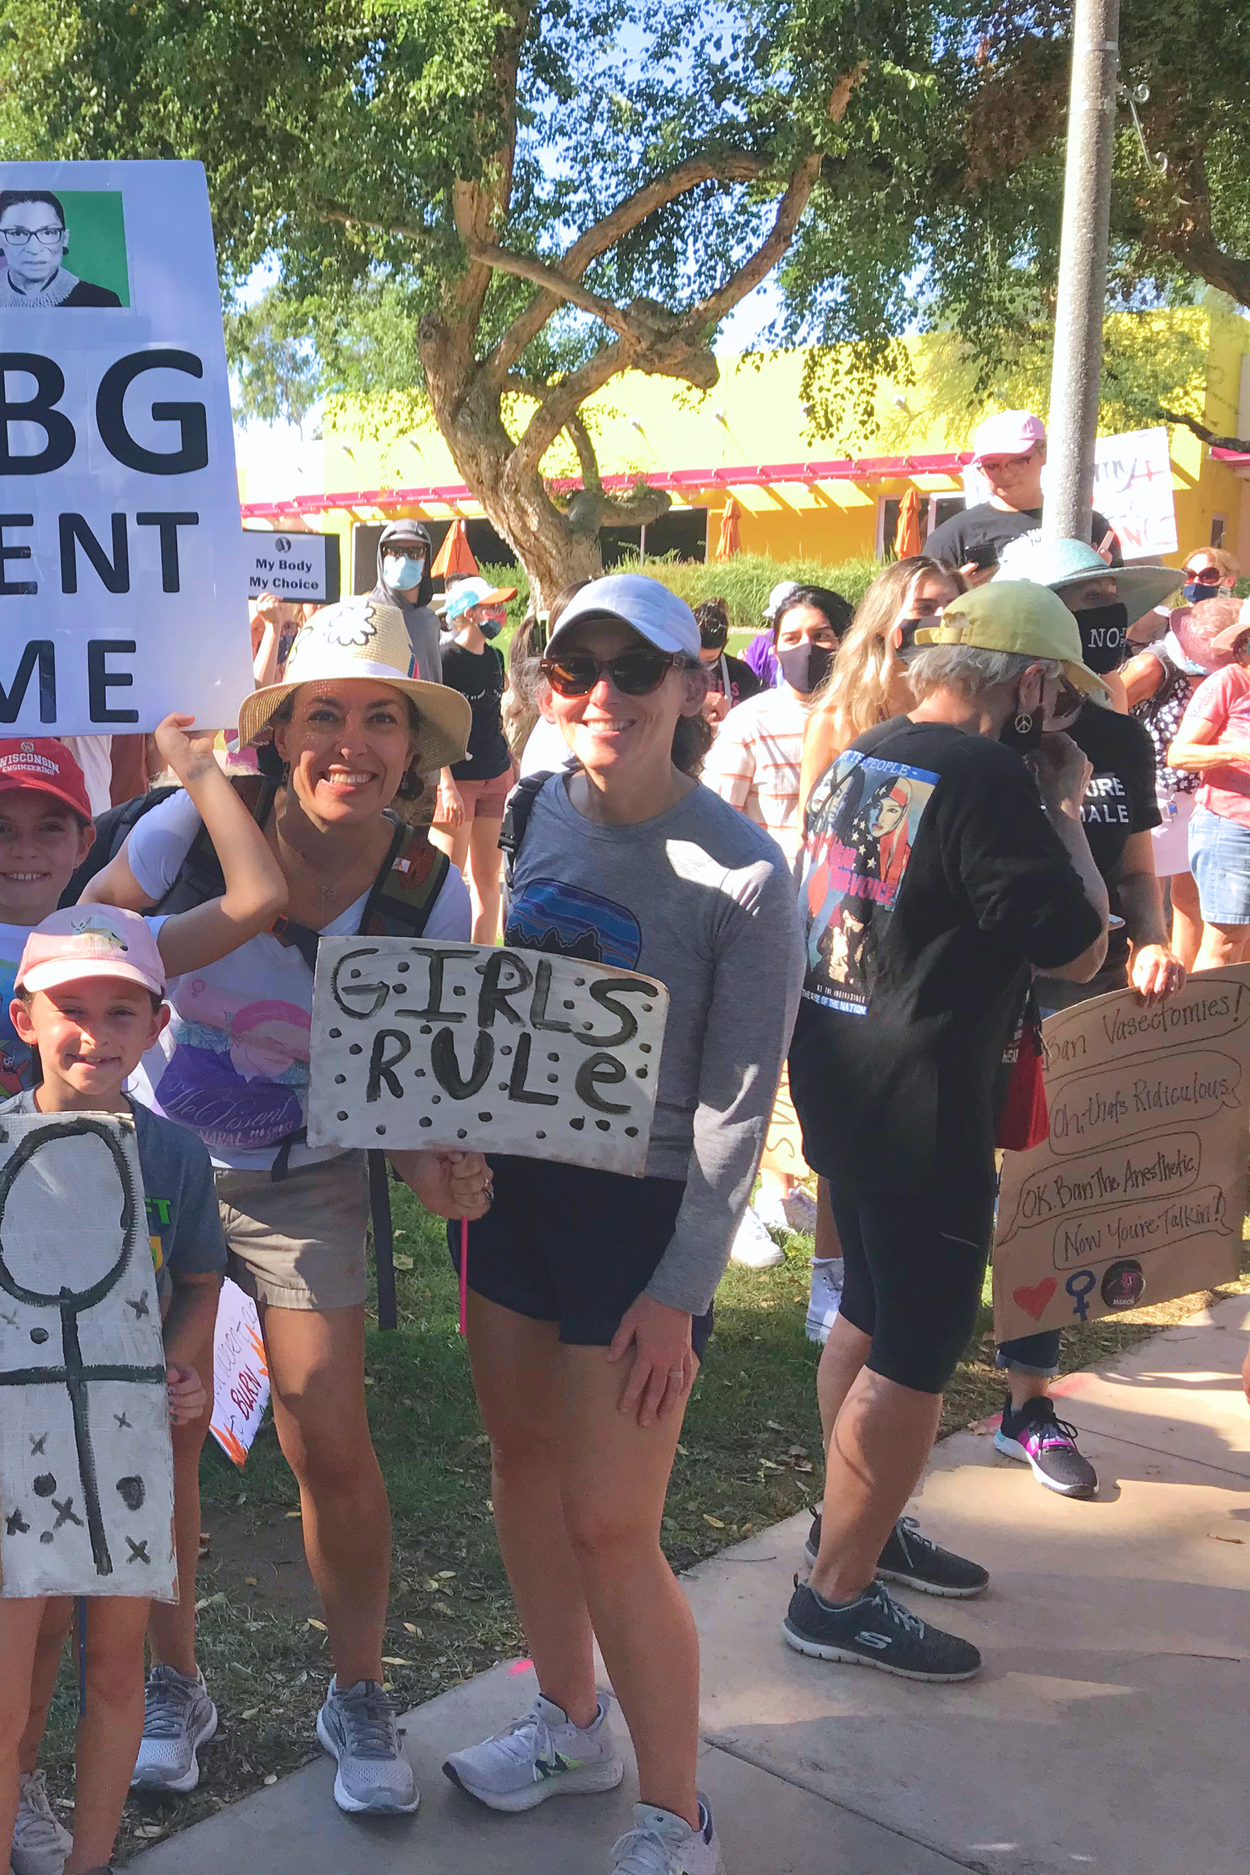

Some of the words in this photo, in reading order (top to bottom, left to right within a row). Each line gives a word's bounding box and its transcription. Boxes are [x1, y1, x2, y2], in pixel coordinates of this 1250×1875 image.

[256, 558, 274, 571] My
[279, 559, 312, 573] Body
[250, 576, 268, 590] My
[272, 577, 319, 590] Choice
[2, 763, 55, 776] ENGINEERING
[865, 757, 911, 777] PEOPLE
[1085, 777, 1126, 797] URE
[1079, 804, 1130, 823] ALE
[331, 946, 658, 1047] GIRLS
[1043, 1032, 1087, 1071] Ban
[1102, 984, 1245, 1045] Vasectomies!
[1055, 1174, 1094, 1209] Ban
[1063, 1222, 1102, 1262] Now
[230, 1363, 263, 1421] BURN
